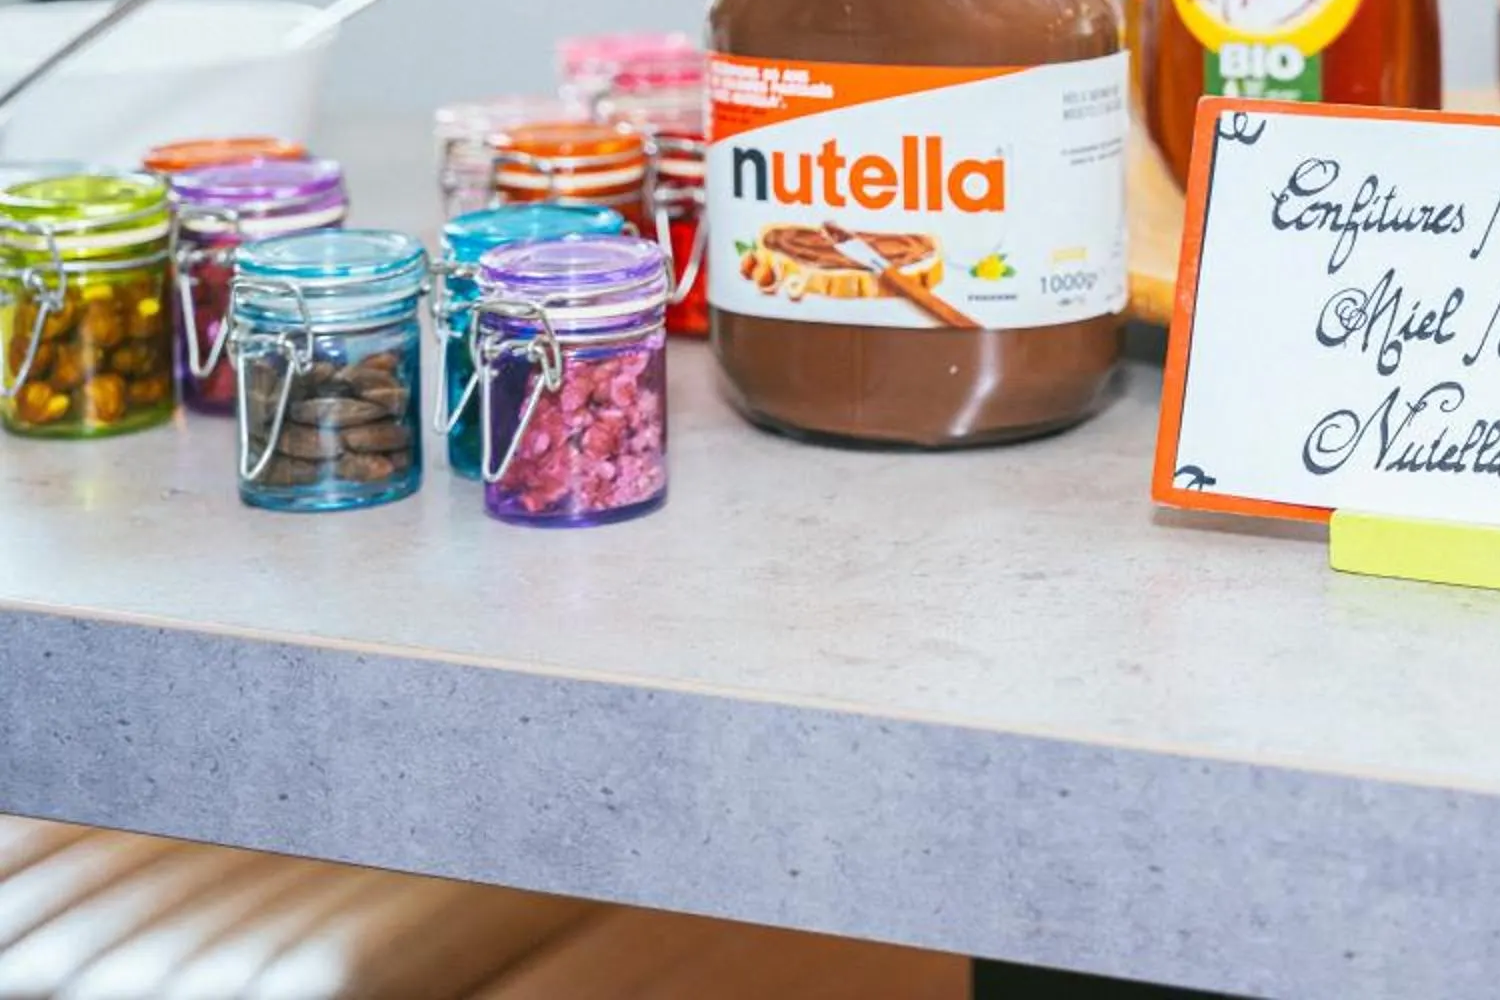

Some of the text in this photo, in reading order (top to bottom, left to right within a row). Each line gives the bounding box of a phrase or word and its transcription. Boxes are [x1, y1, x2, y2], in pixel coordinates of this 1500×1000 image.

[1219, 42, 1305, 81] BIO
[732, 134, 1005, 213] nutella
[1271, 157, 1466, 275] Confitures
[1315, 267, 1464, 376] Miel
